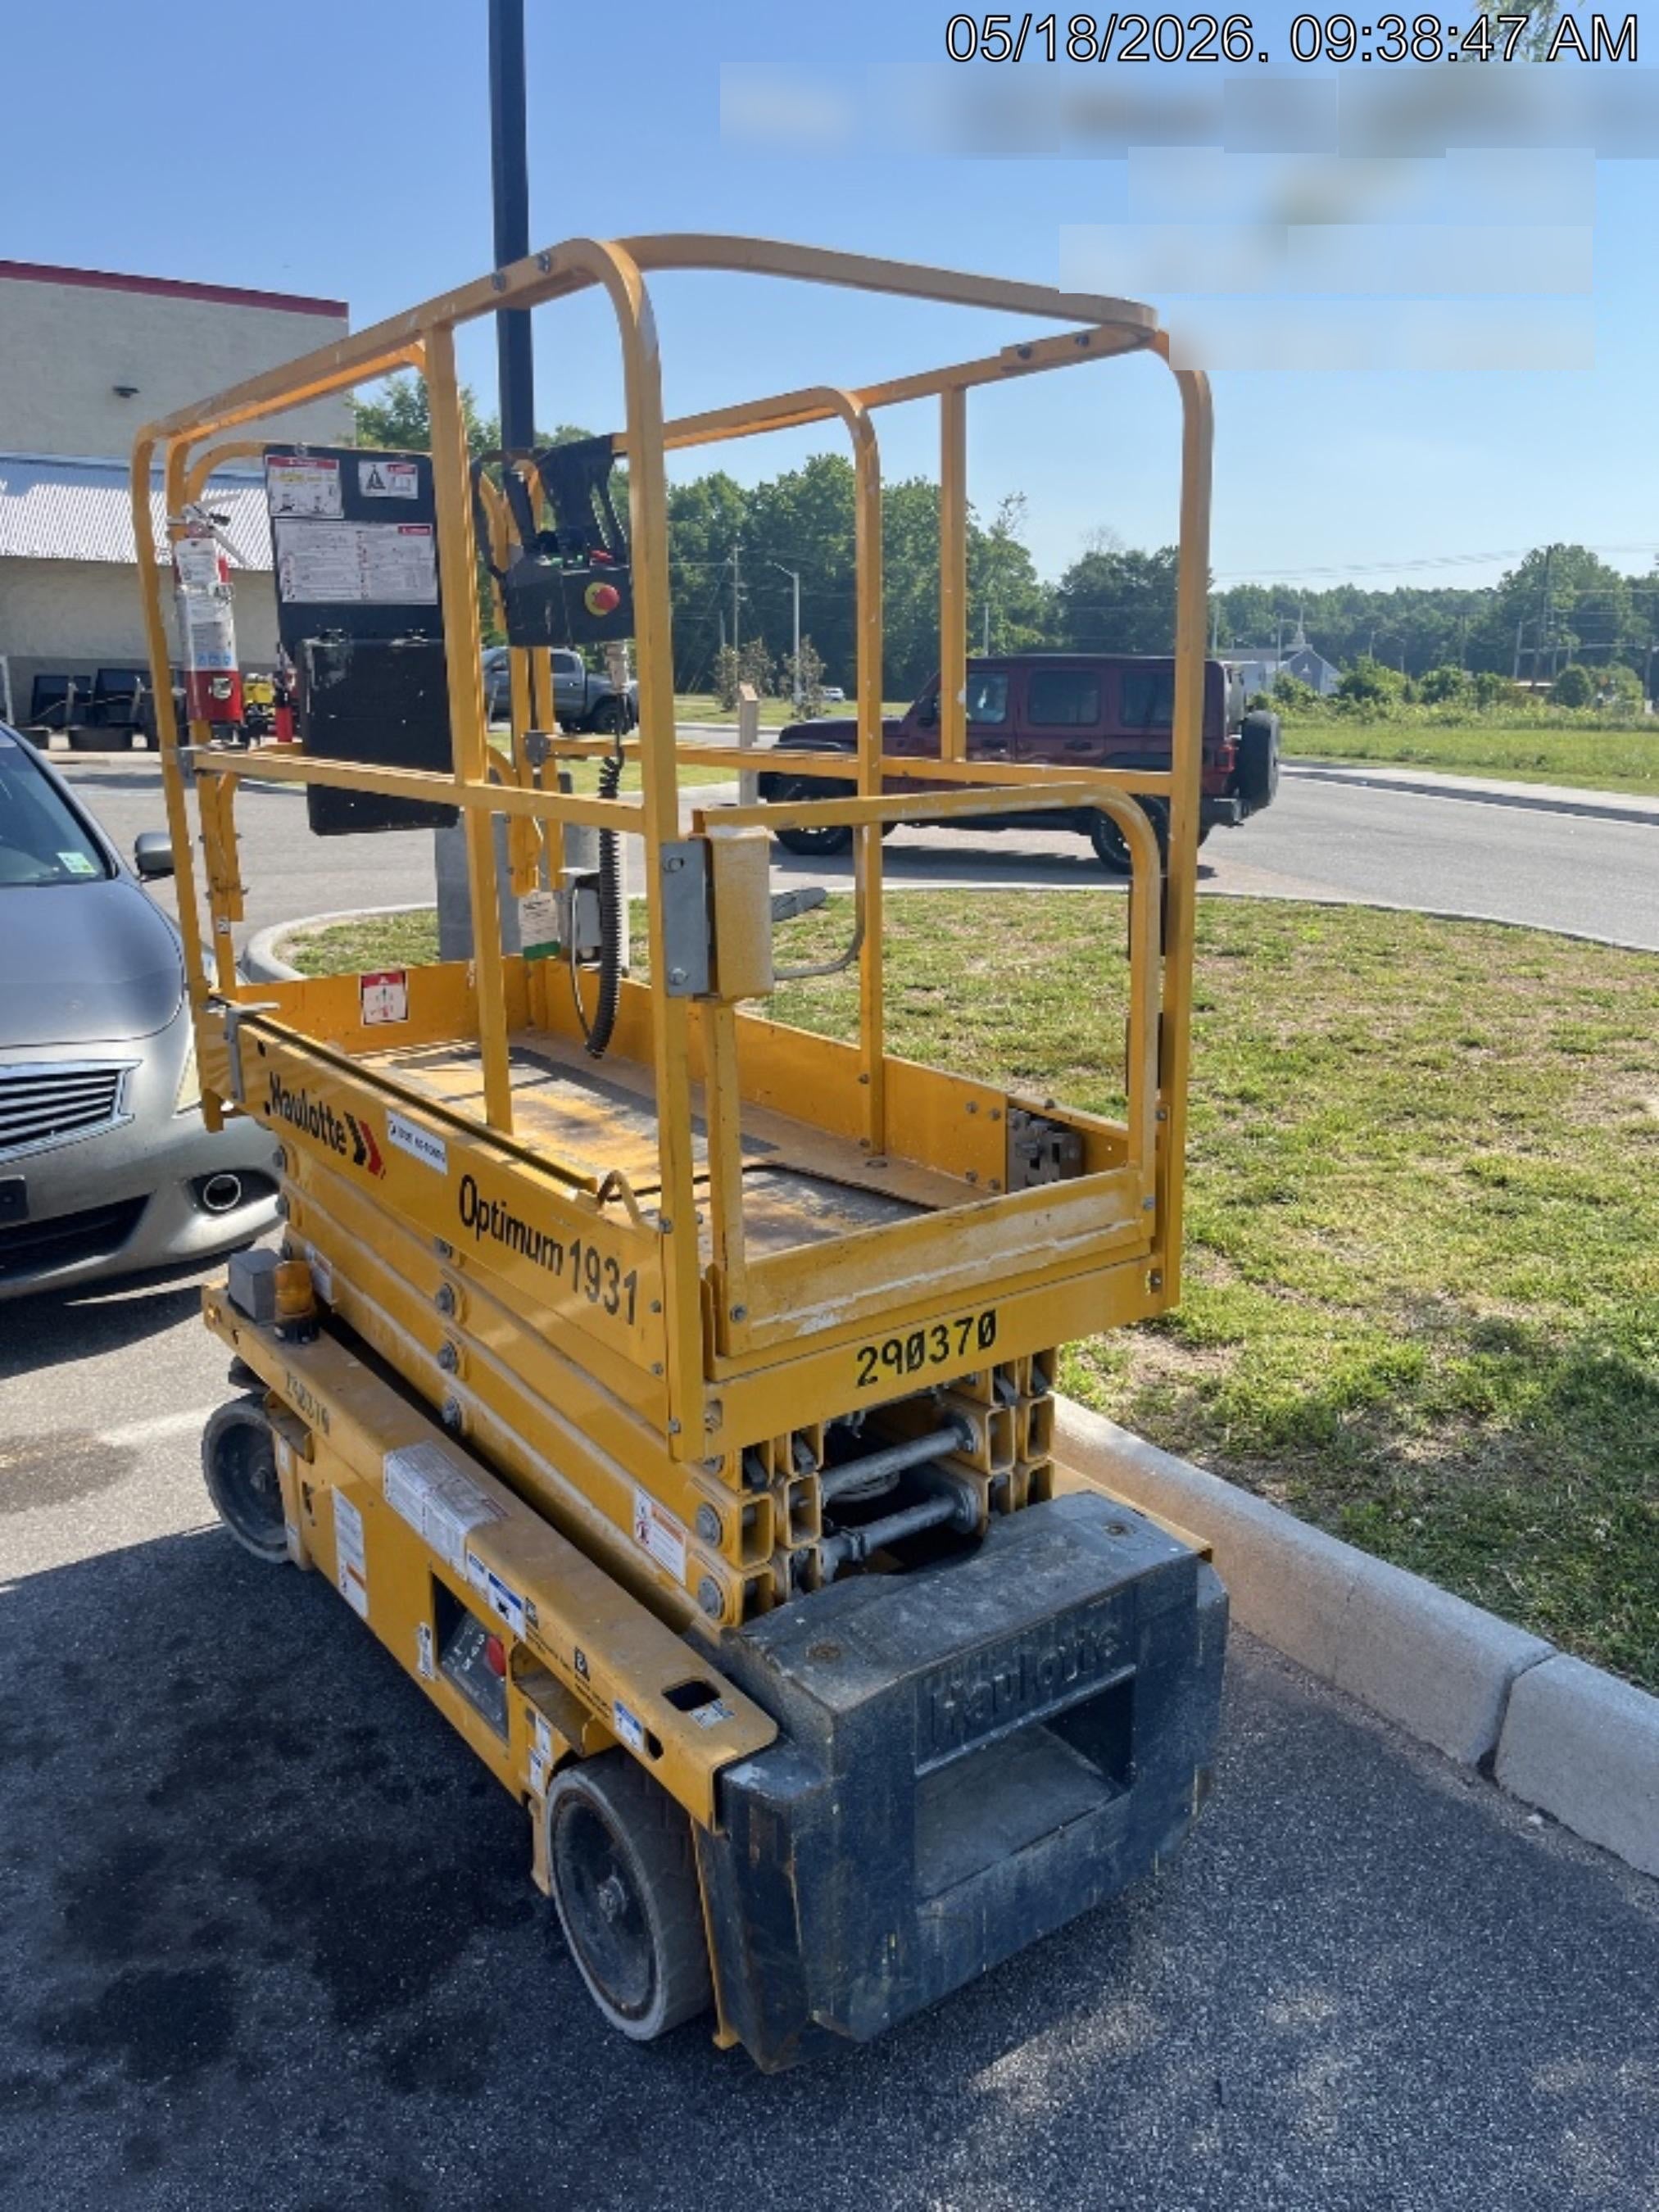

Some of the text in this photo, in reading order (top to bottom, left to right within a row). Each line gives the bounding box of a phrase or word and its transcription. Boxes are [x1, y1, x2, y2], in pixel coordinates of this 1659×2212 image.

[270, 1071, 347, 1156] Haulotte
[460, 1174, 637, 1326] Optimum 1931
[856, 1308, 996, 1387] 290370
